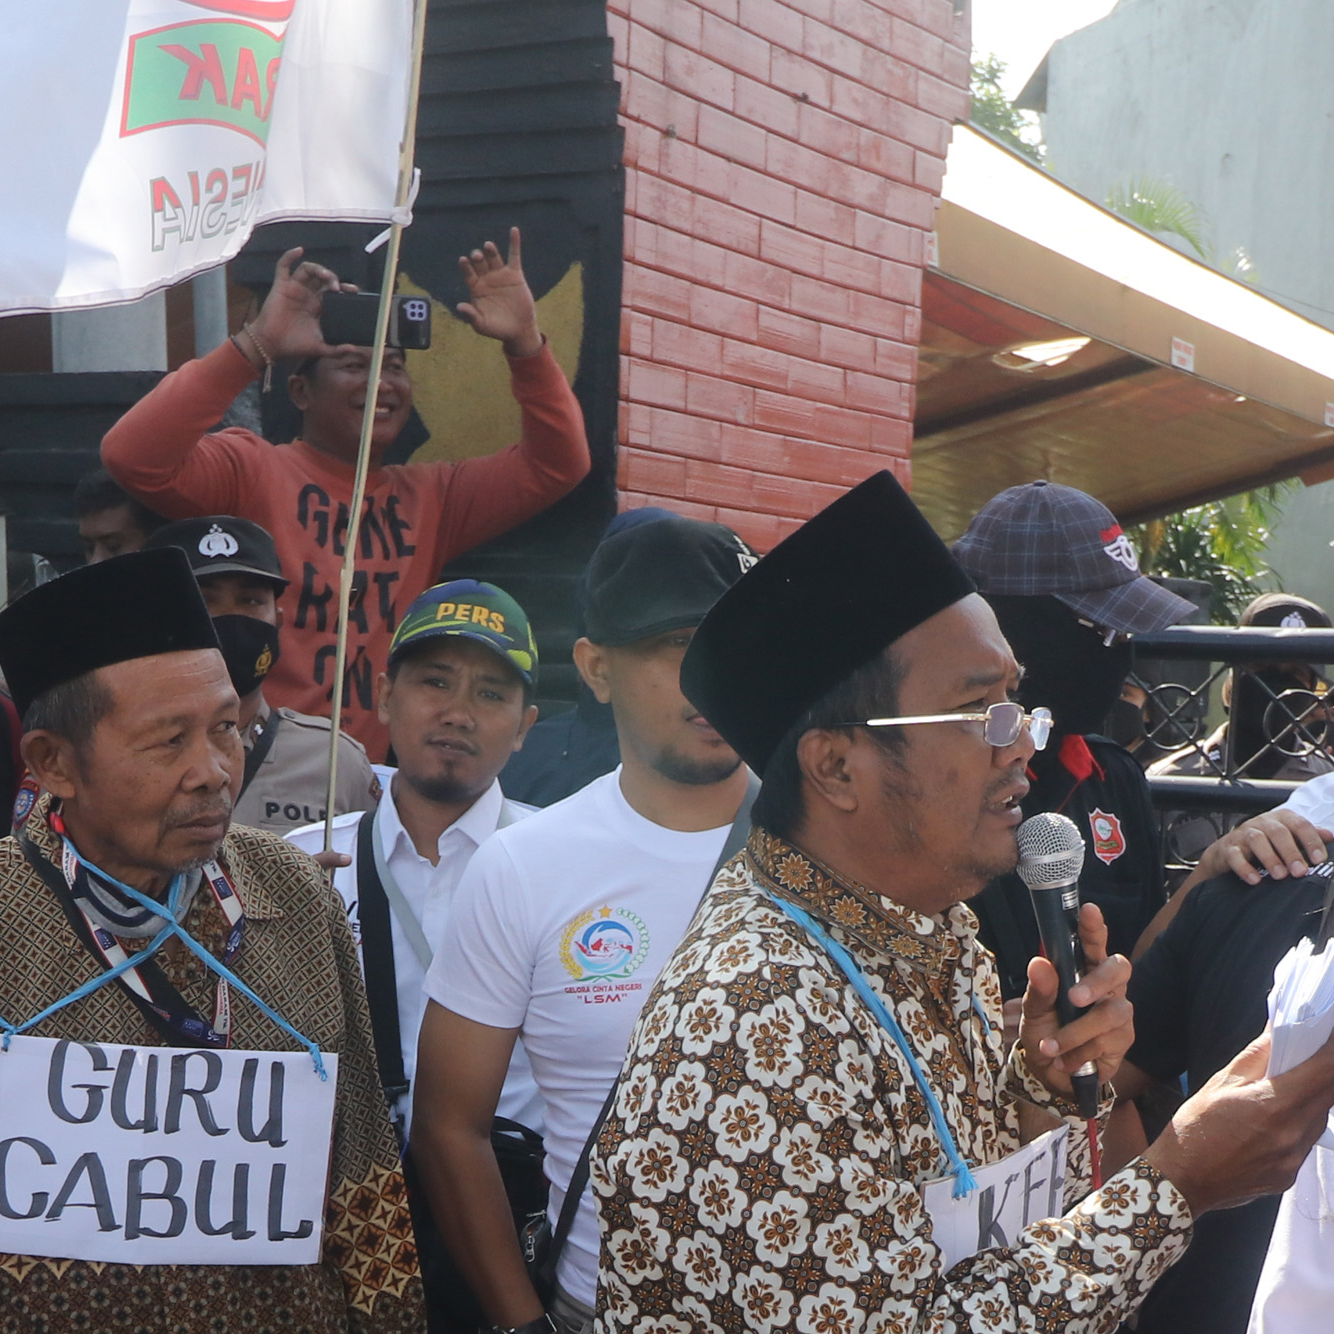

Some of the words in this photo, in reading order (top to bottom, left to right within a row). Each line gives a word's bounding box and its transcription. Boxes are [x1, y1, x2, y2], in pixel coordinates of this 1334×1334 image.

[435, 602, 505, 633] PERS
[564, 985, 591, 994] GELORA
[592, 985, 614, 993] CINTA
[48, 1039, 288, 1148] GURU
